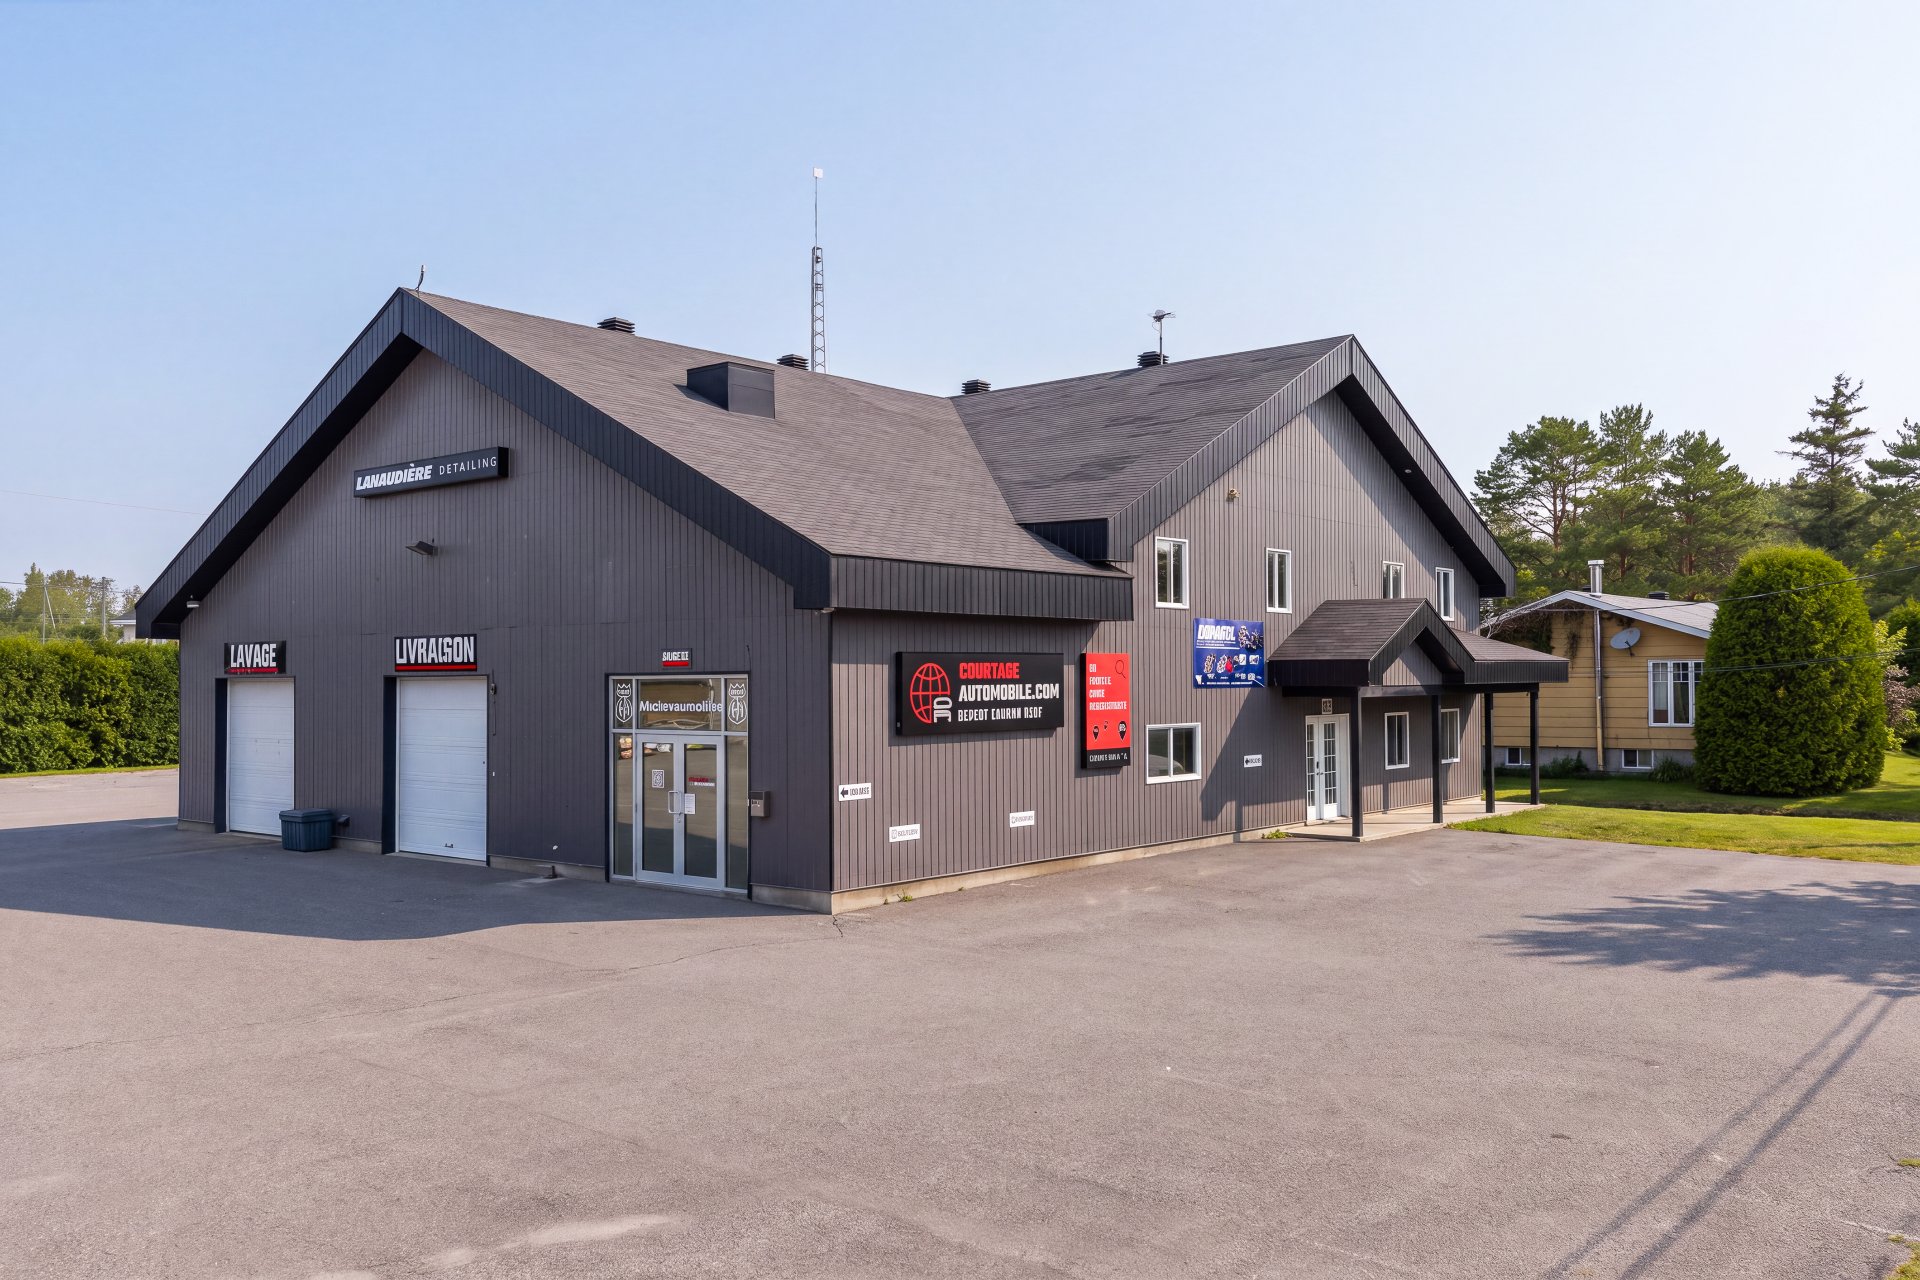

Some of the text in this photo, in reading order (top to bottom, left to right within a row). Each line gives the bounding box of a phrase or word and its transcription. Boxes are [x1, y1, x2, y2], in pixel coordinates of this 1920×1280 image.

[356, 456, 497, 491] LANAUDIÈRE DETAILING
[230, 643, 277, 668] LAVAGE
[959, 662, 1020, 680] COURTAGE
[958, 683, 1060, 702] AUTOMOBILE.COM
